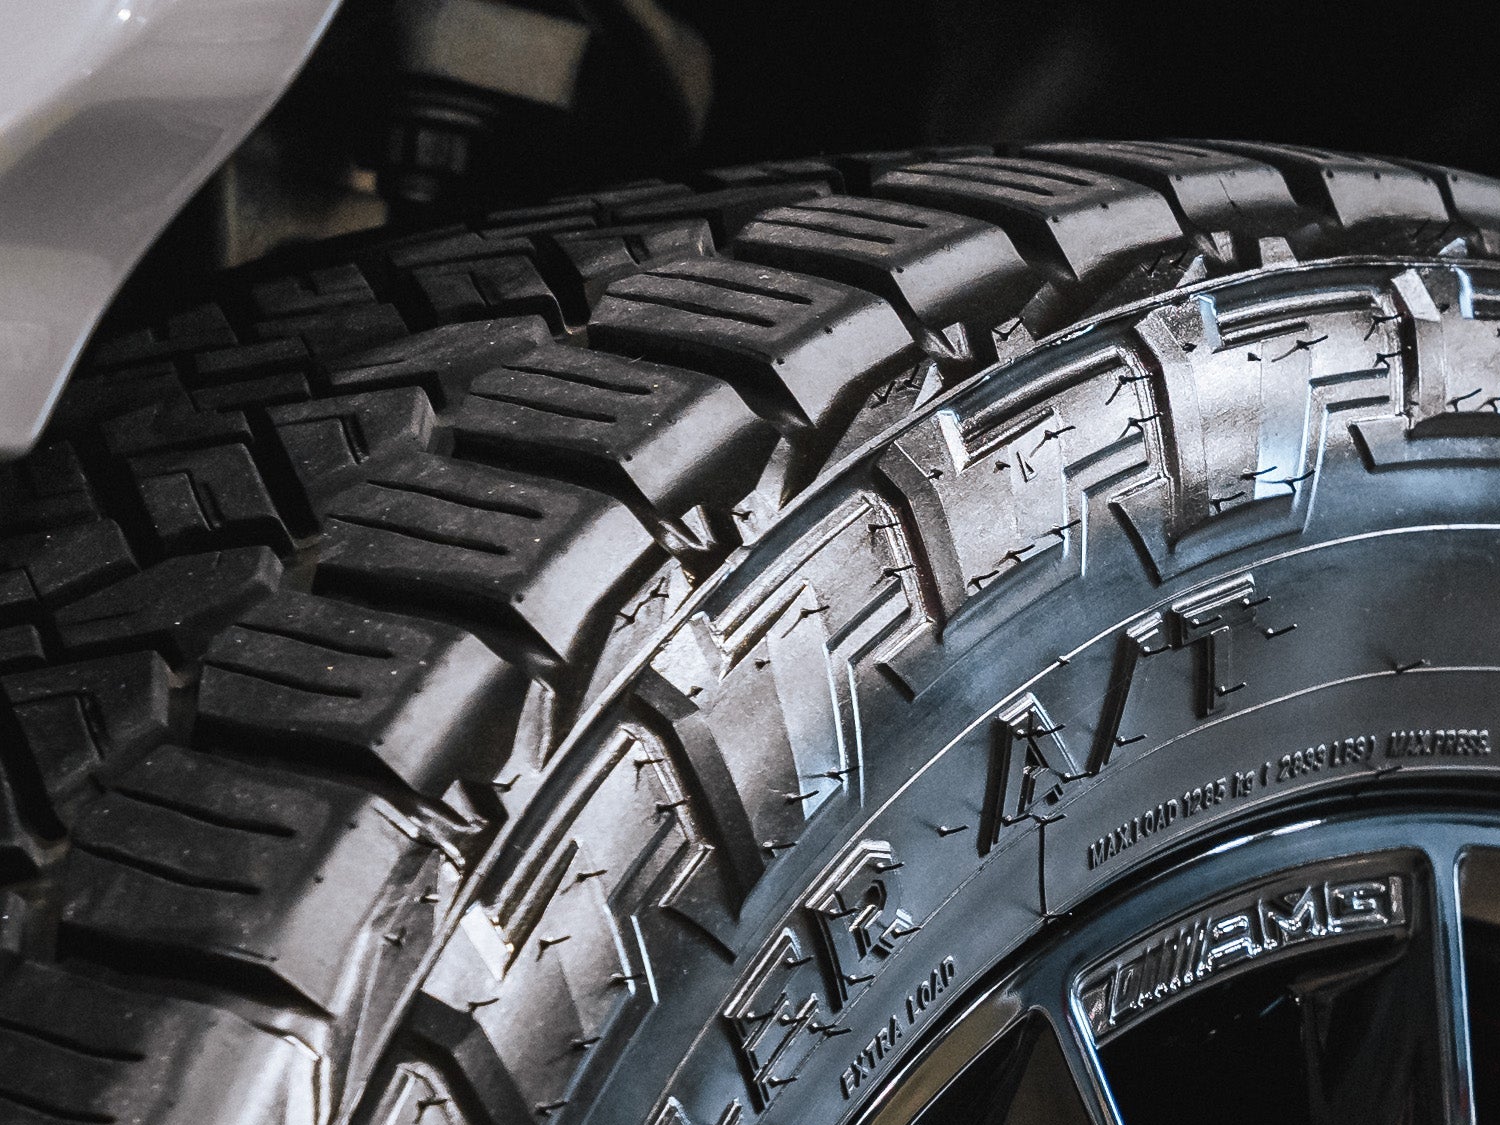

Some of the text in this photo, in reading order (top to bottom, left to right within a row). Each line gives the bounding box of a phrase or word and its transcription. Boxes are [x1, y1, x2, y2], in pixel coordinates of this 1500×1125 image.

[978, 573, 1258, 857] A/T
[1182, 777, 1226, 818] 1285
[1232, 770, 1255, 797] kg
[838, 954, 957, 1100] EXTRA LOAD
